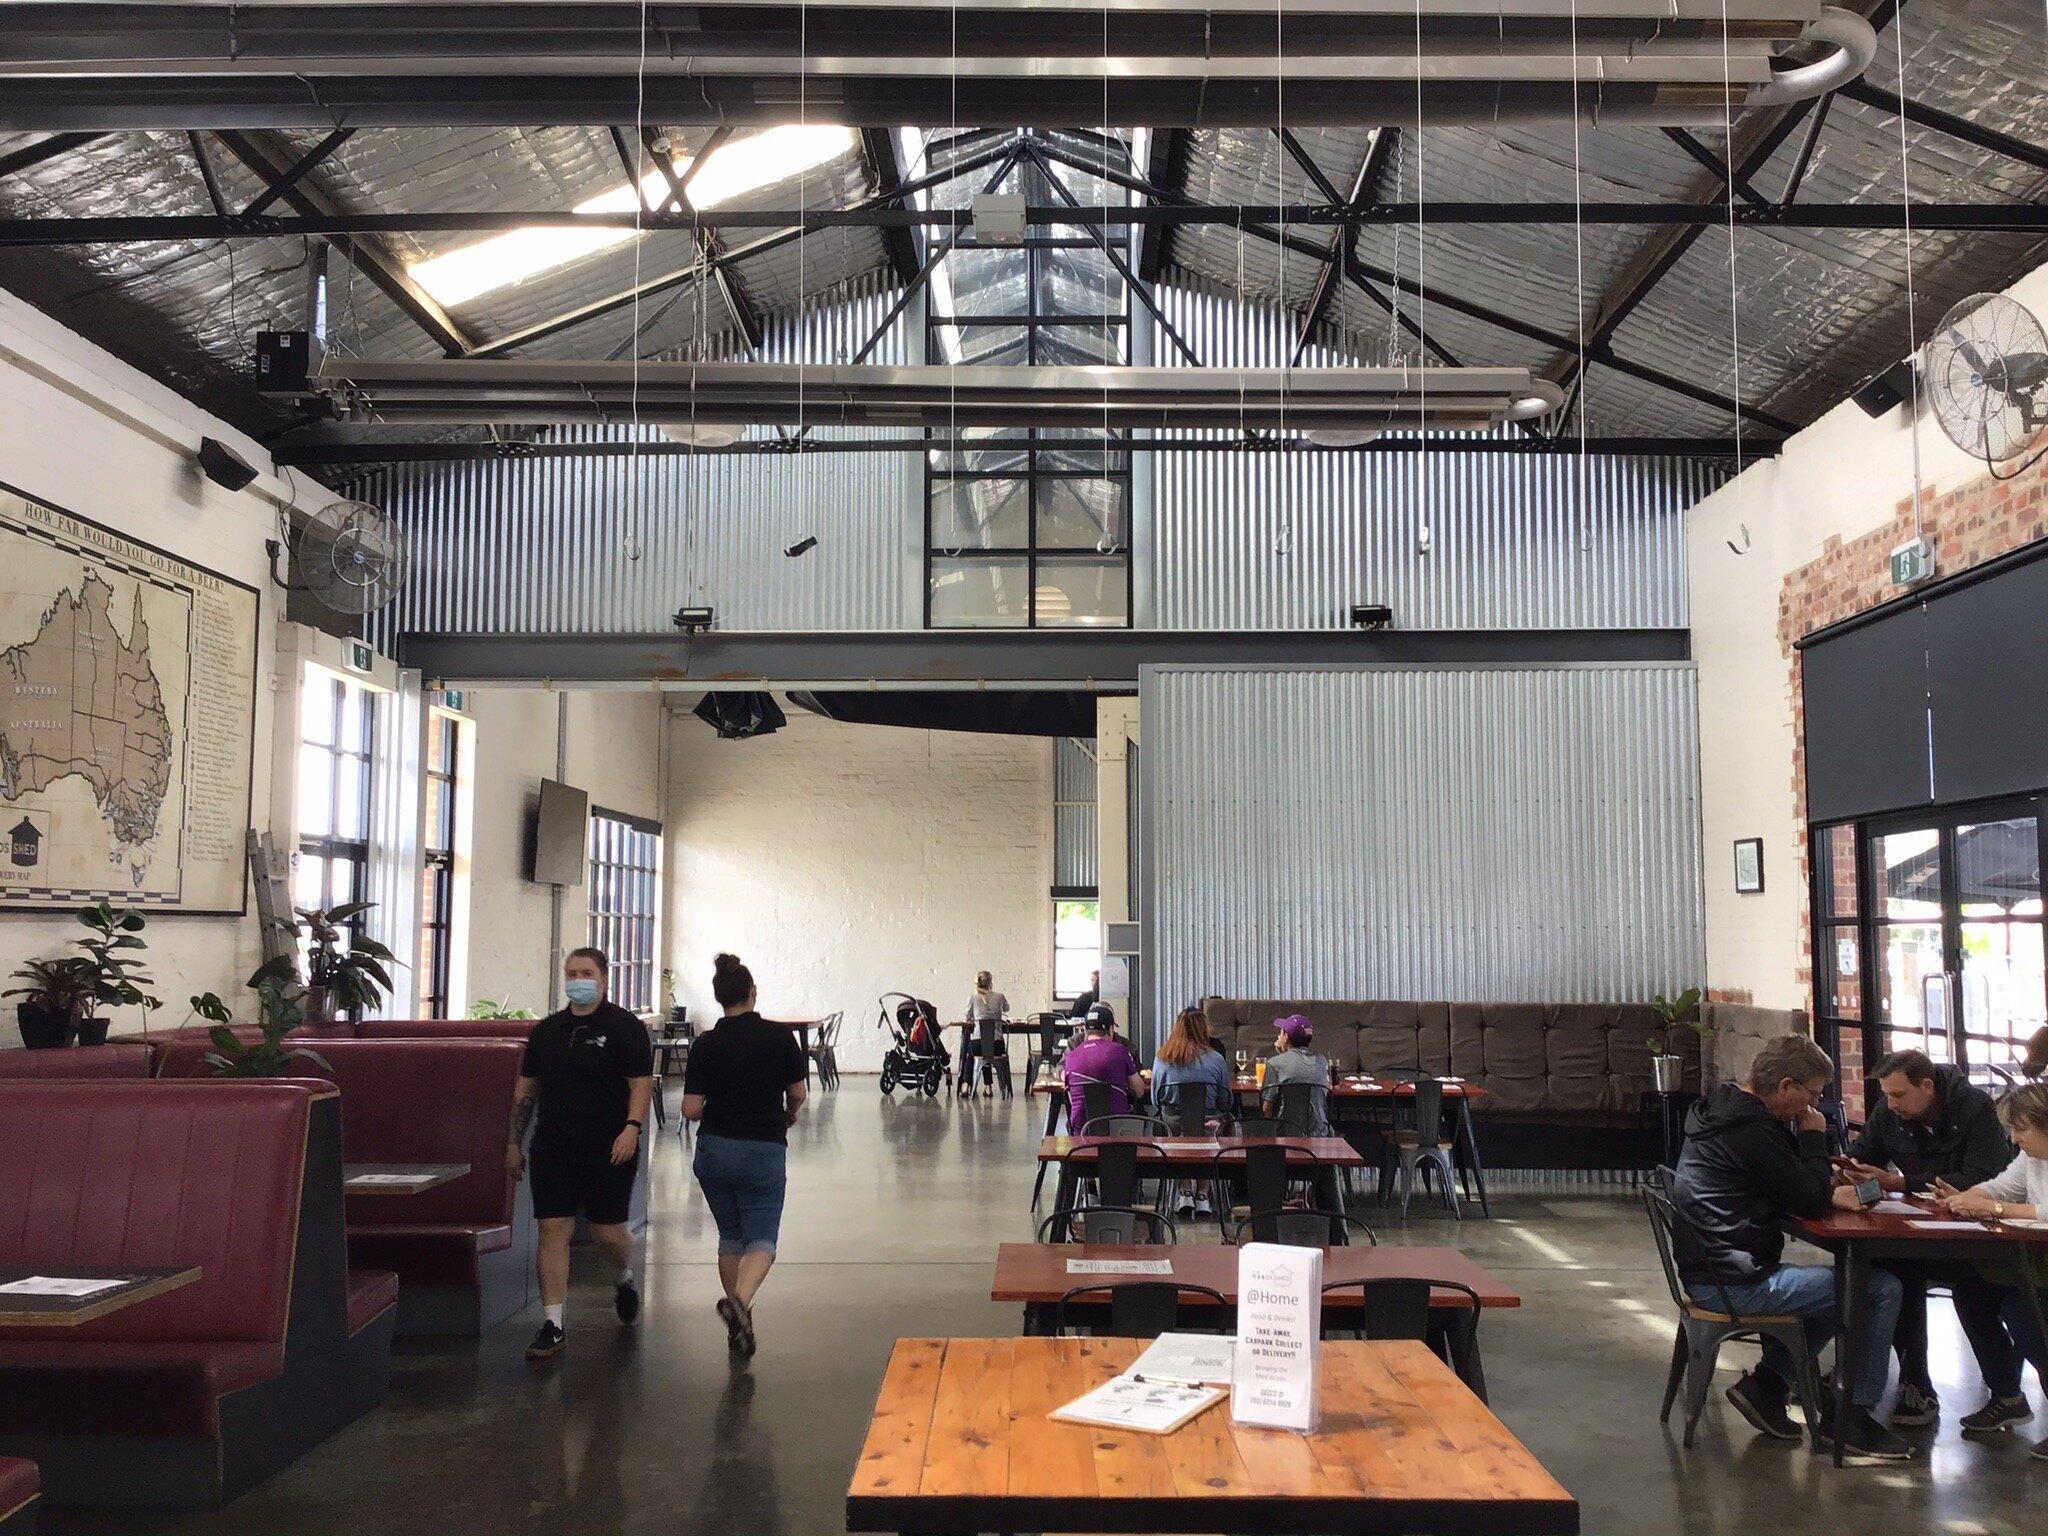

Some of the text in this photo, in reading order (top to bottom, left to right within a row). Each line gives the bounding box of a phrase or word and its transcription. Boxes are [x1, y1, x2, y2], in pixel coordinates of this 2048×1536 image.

[25, 502, 224, 592] HOW FAR WOULD YOU GO FOR A BEER?
[13, 843, 37, 856] SHED
[1247, 1289, 1299, 1306] @Home
[1275, 1340, 1302, 1349] COLLECT
